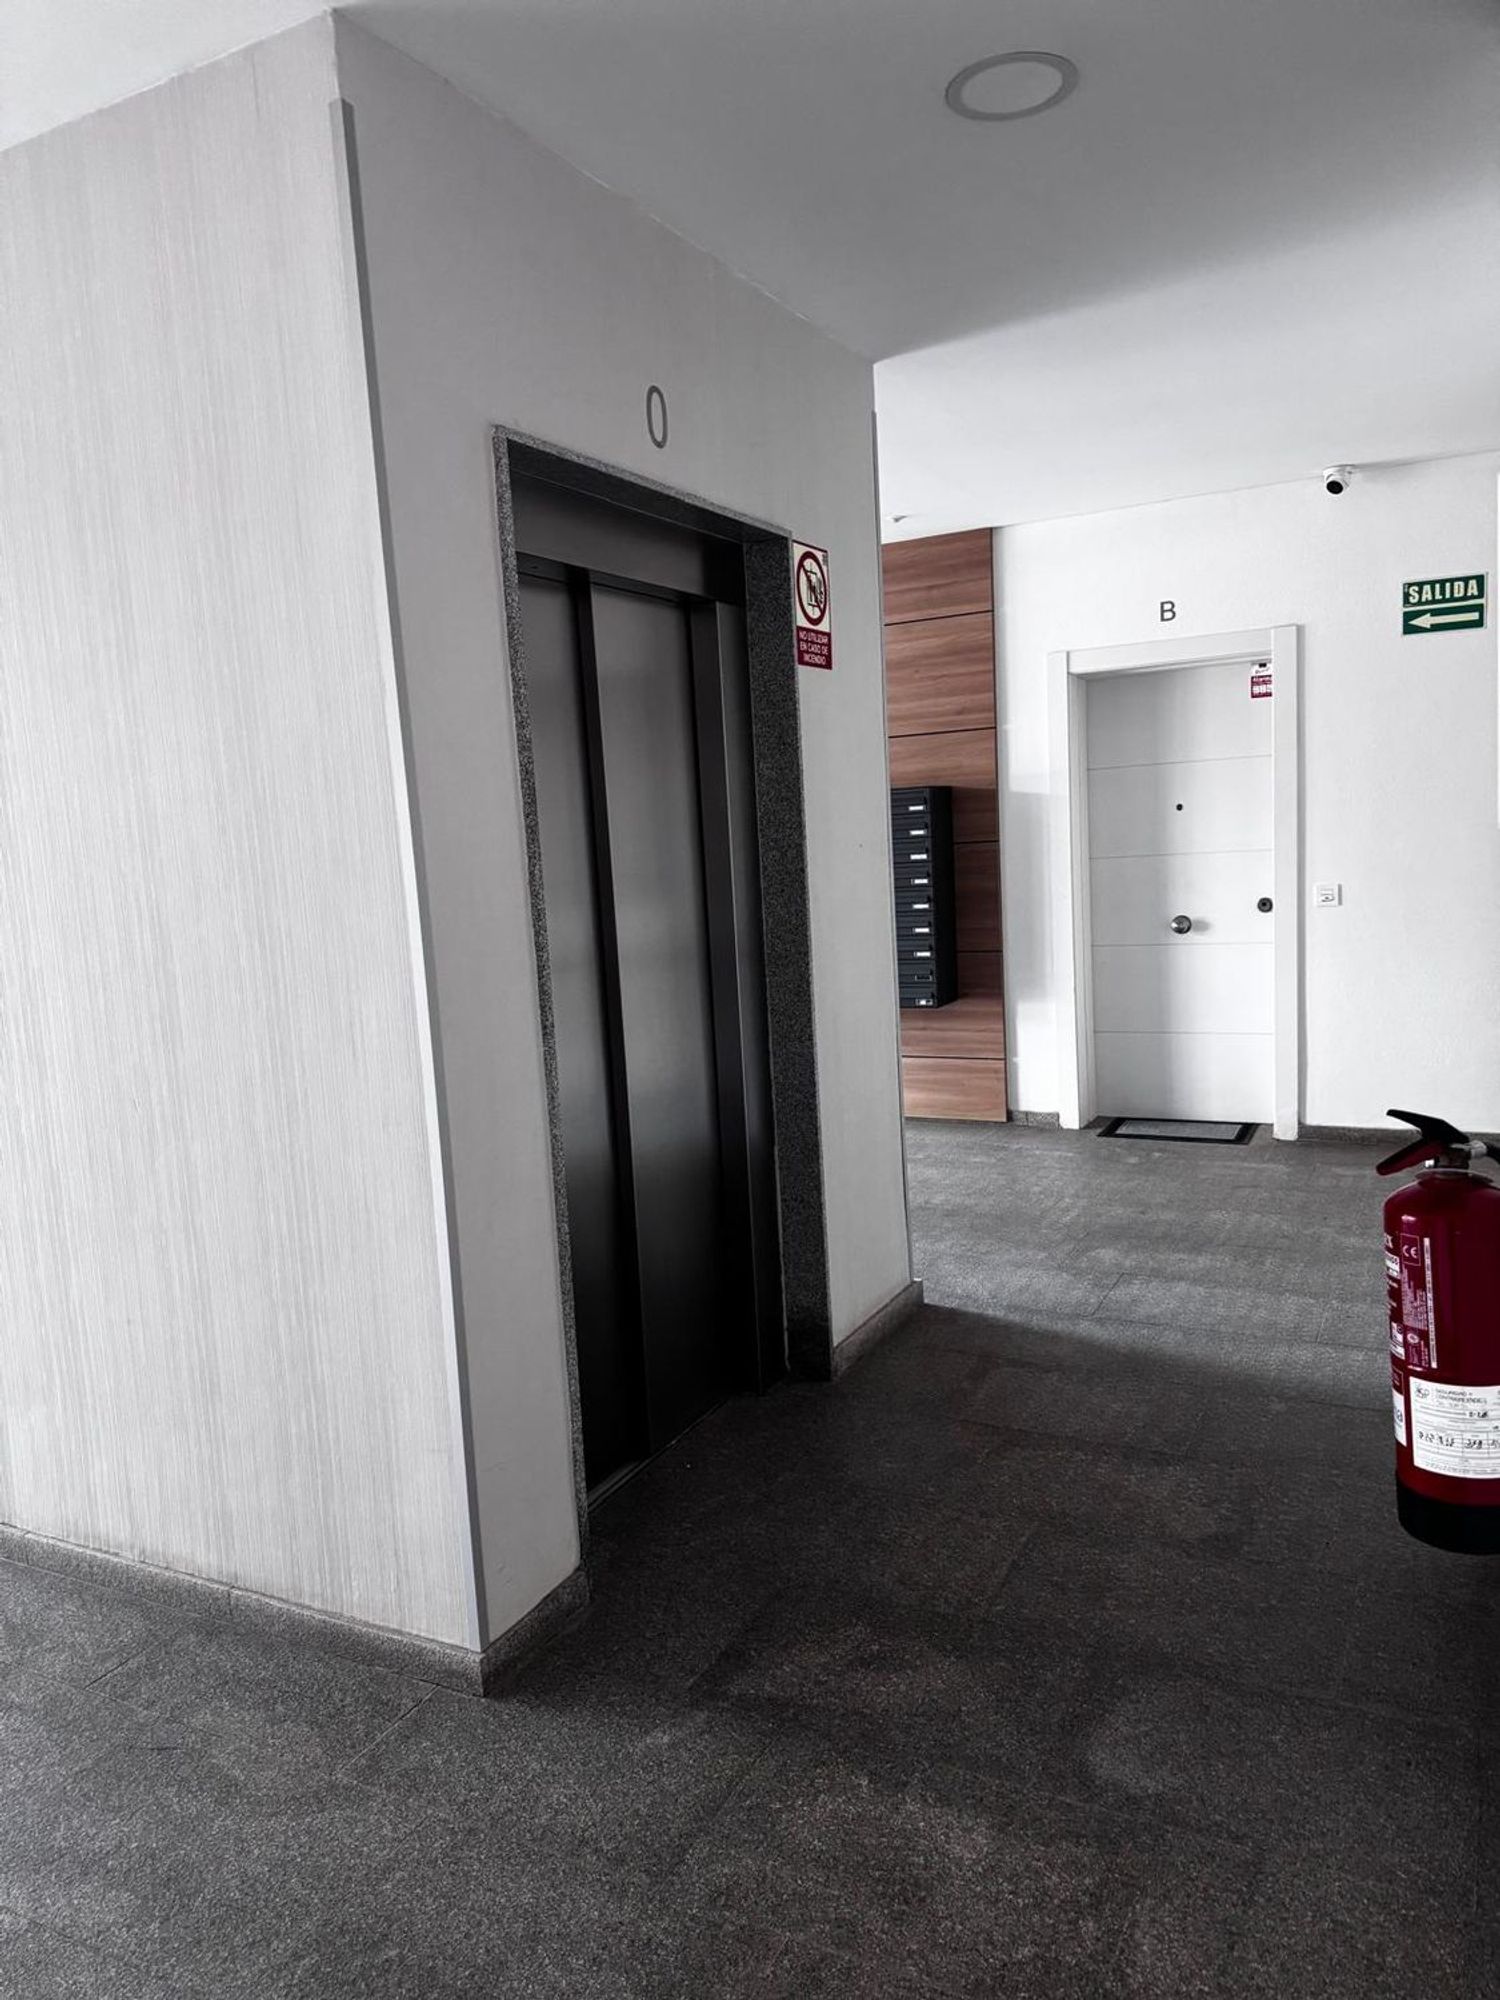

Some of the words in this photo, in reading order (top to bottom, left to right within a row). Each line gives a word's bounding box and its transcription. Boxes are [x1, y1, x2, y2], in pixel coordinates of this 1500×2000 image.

[646, 385, 668, 449] 0
[1408, 579, 1479, 603] SALIDA
[1160, 600, 1176, 622] B
[799, 631, 807, 640] NO
[807, 632, 829, 645] UTILIZAR
[800, 641, 807, 651] EN
[808, 643, 821, 654] CASO
[822, 646, 829, 656] DE
[803, 654, 827, 666] INCENDIO
